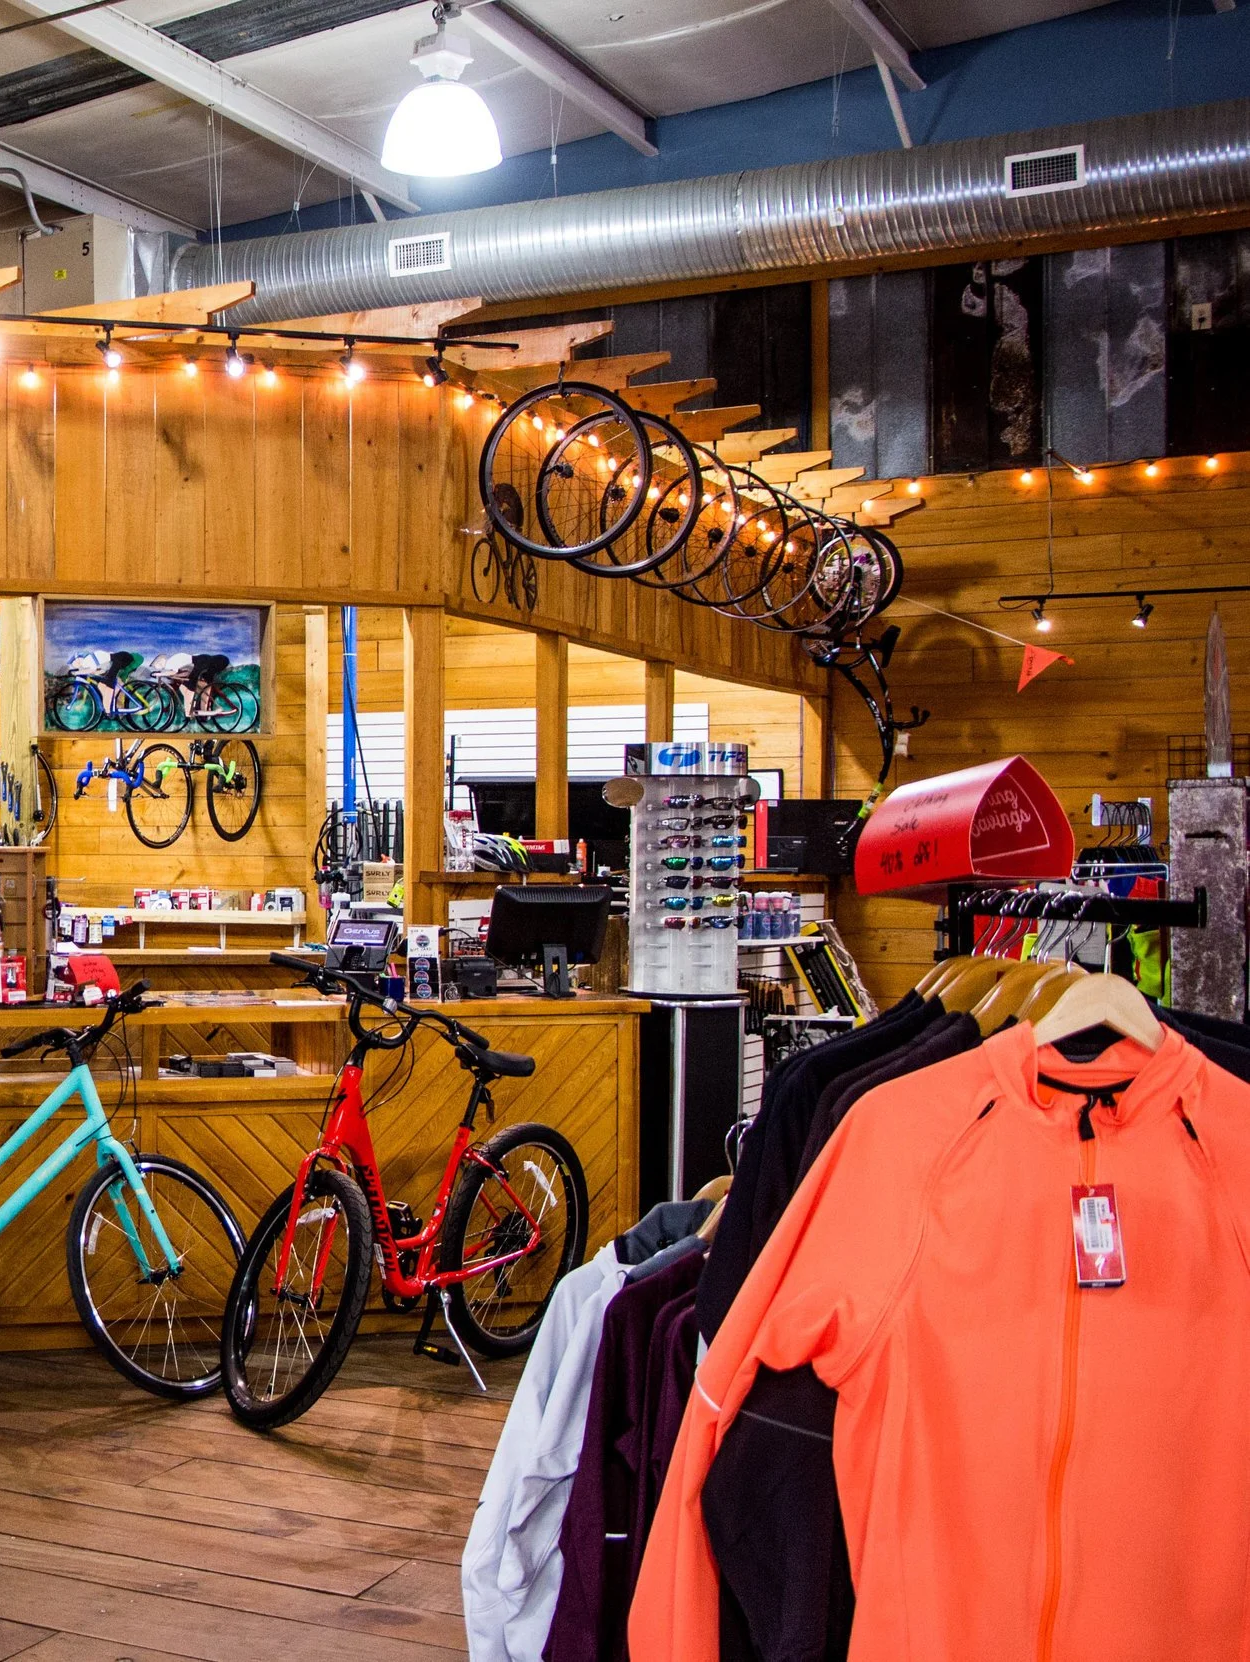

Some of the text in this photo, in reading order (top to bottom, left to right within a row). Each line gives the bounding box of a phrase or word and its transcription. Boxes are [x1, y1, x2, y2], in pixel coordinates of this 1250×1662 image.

[81, 241, 90, 257] 5
[365, 869, 391, 877] SURLY
[365, 888, 390, 897] SURLY
